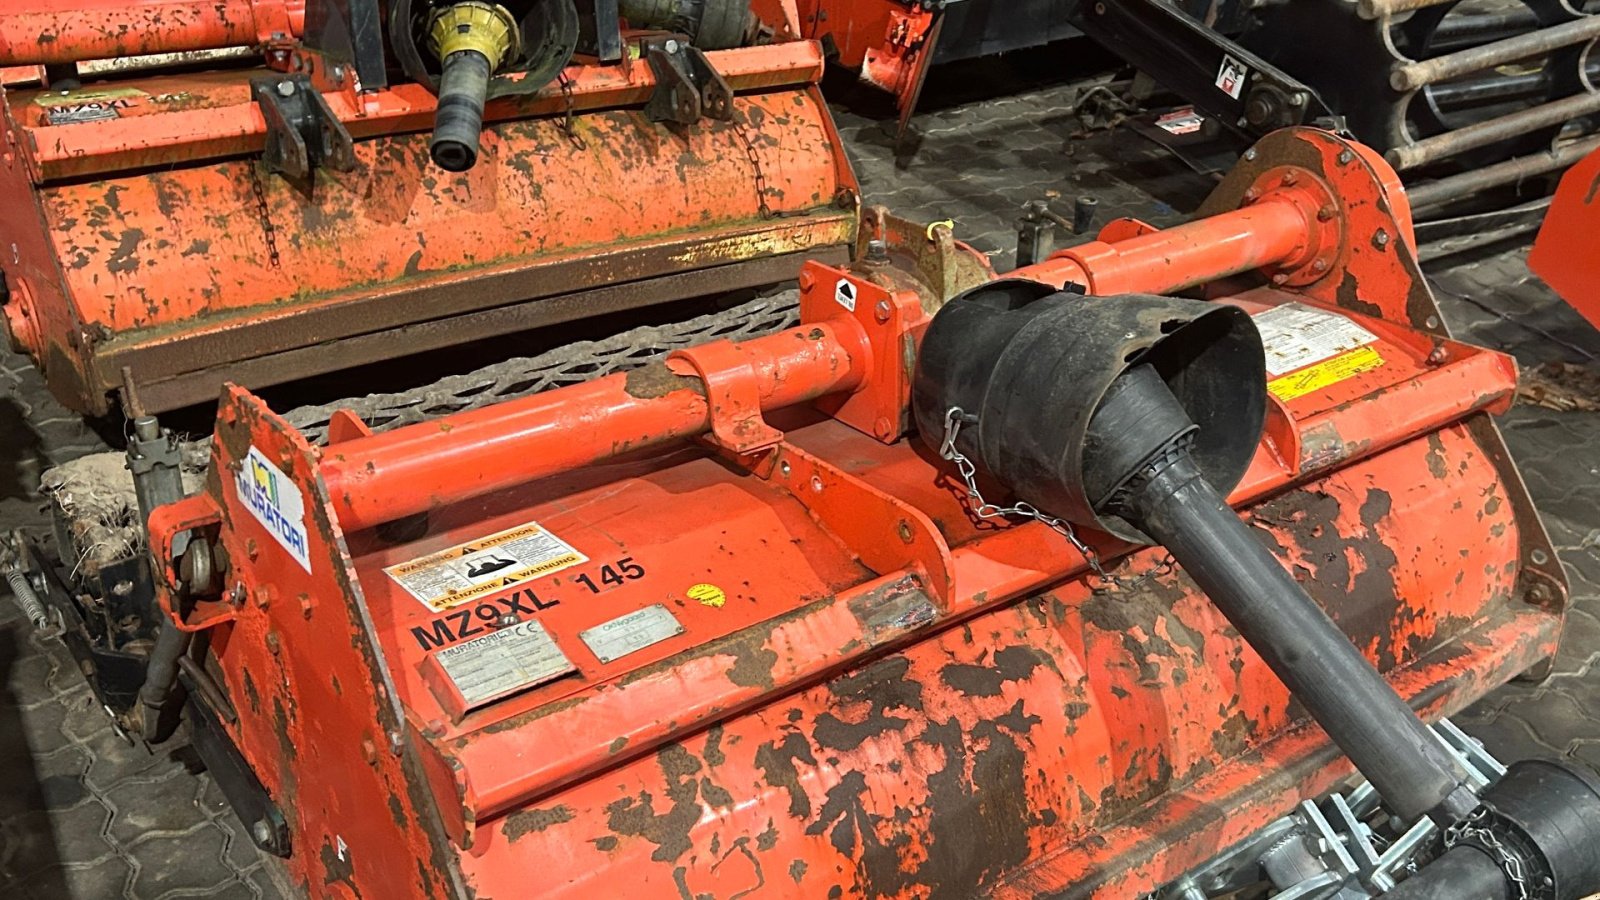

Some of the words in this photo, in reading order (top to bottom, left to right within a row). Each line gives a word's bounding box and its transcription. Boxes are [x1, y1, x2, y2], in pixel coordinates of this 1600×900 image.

[238, 472, 305, 559] MURATORI
[480, 528, 533, 548] ATTENTION
[399, 554, 453, 573] WARNING
[519, 556, 576, 577] WARNUNG
[411, 589, 560, 651] MZ9XL
[575, 557, 645, 594] 145
[434, 582, 499, 607] ATTENZIONE
[443, 633, 500, 657] MURATORI
